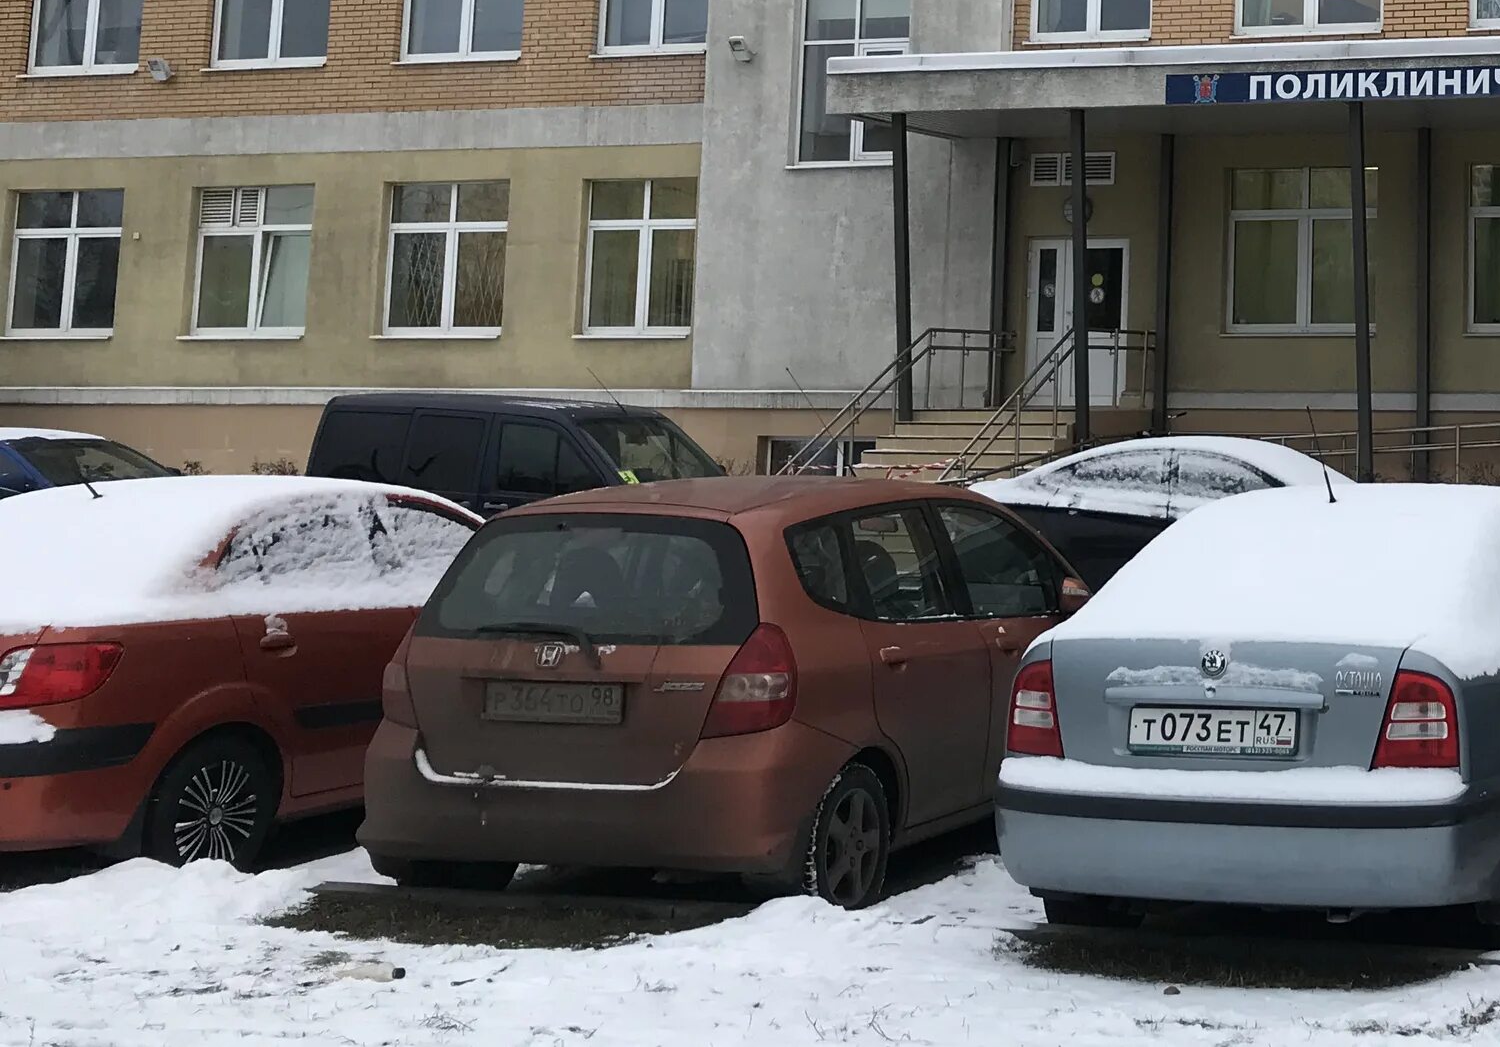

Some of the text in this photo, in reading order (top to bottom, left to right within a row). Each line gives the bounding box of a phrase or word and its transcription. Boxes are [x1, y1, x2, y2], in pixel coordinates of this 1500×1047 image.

[591, 687, 614, 706] 98
[1142, 713, 1286, 743] Т073ЕТ 47
[1256, 736, 1276, 745] RUS
